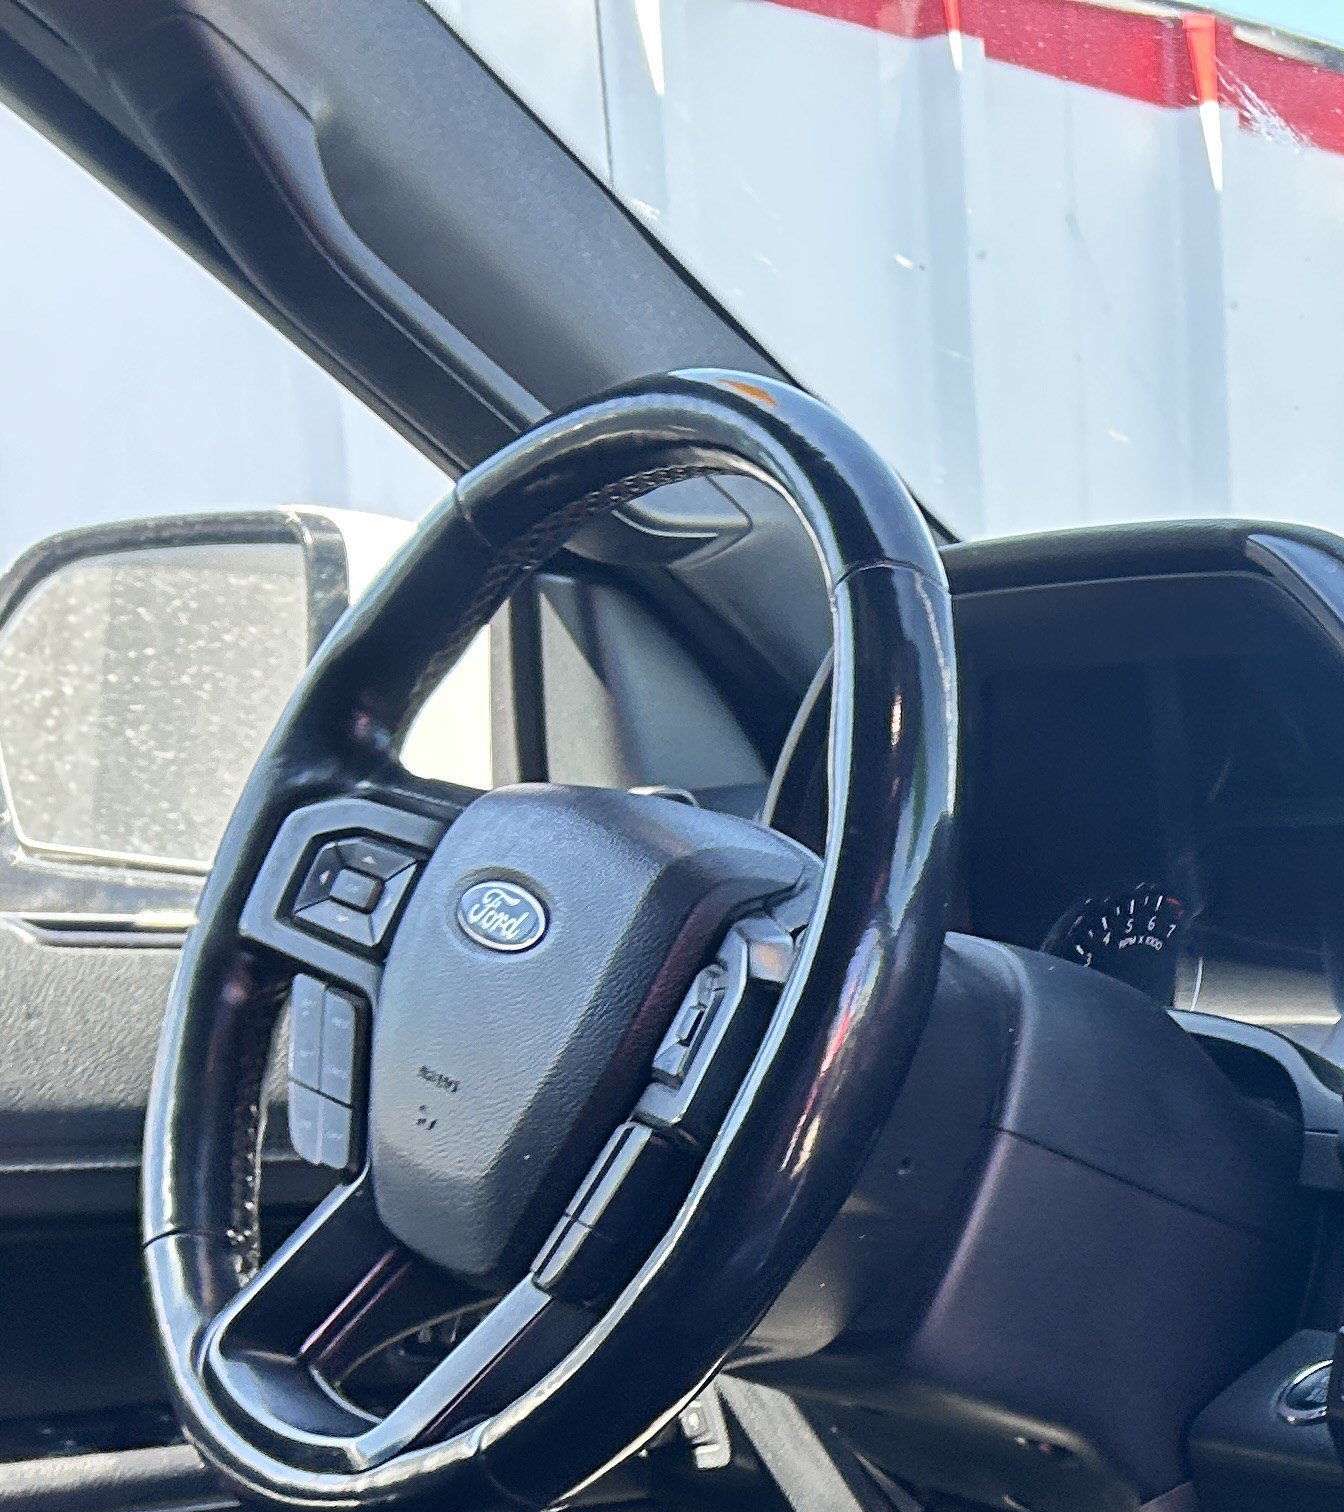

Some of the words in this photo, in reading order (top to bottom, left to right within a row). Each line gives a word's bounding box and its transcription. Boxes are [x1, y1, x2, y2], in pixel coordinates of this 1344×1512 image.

[467, 888, 530, 940] Ford
[1124, 918, 1135, 934] 5
[1147, 915, 1157, 932] 6
[1165, 923, 1177, 939] 7
[1102, 931, 1112, 946] 4
